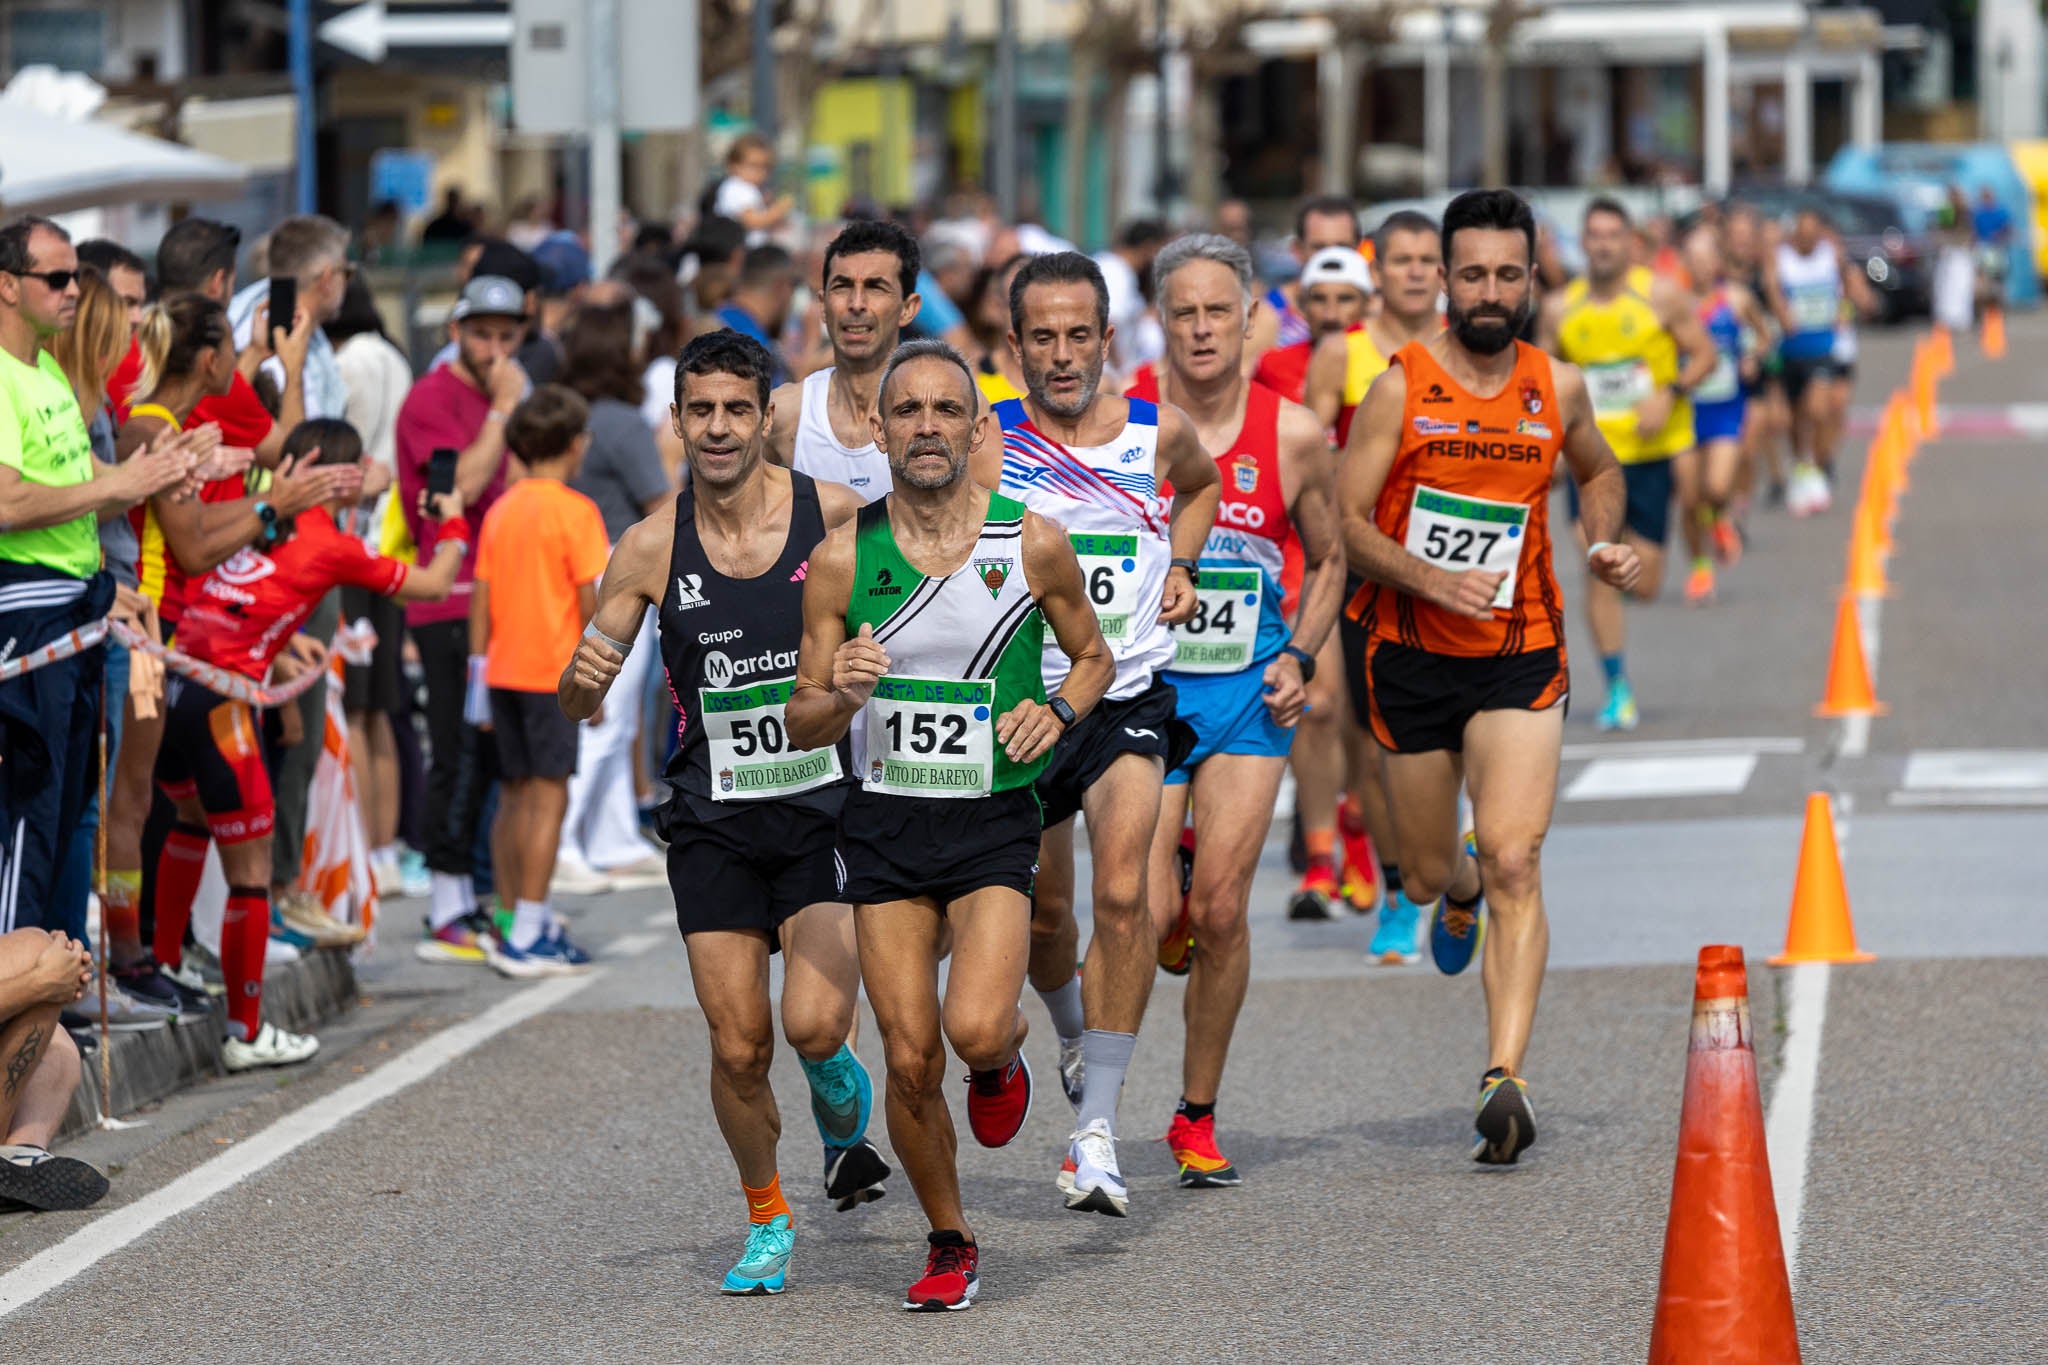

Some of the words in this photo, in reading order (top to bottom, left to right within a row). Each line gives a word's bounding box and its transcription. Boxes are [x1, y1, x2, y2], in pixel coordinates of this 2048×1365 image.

[1427, 440, 1542, 463] REINOSA
[1076, 539, 1094, 553] DE
[1104, 540, 1131, 555] AJO
[1424, 523, 1502, 565] 527
[869, 586, 902, 596] VIATOR
[1081, 566, 1115, 605] 6
[1168, 600, 1236, 634] 84
[698, 629, 743, 644] Grupo
[704, 650, 798, 688] Mardar
[708, 693, 753, 712] COSTA
[761, 688, 781, 704] DE
[925, 685, 945, 701] DE
[954, 687, 985, 703] AJO
[730, 715, 807, 757] 50
[885, 711, 968, 755] 152
[735, 769, 764, 788] AYTO
[766, 766, 781, 785] DE
[783, 756, 827, 783] BAREYO
[885, 765, 909, 784] AYTO
[911, 768, 927, 785] DE
[930, 768, 979, 786] BAREYO
